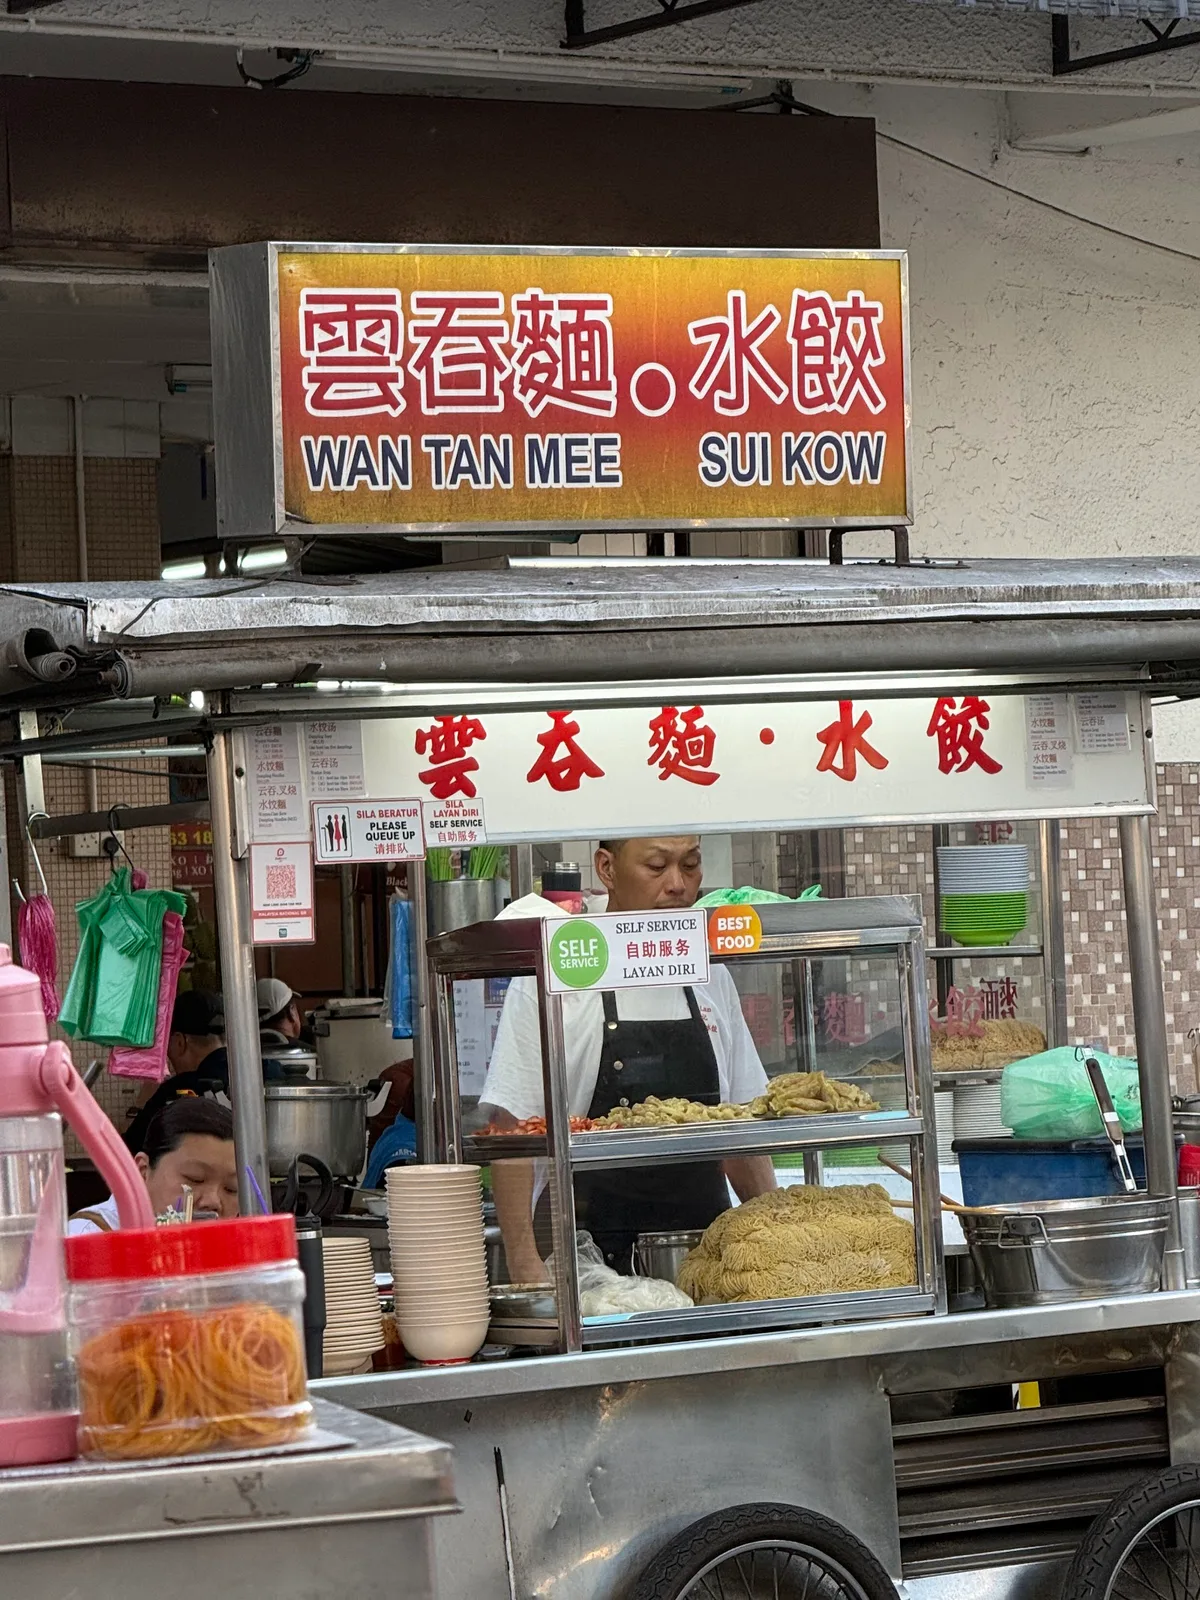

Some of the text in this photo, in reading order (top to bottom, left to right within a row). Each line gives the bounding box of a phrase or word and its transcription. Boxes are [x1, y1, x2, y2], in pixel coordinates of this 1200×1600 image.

[300, 288, 887, 417] 雲吞麵 水餃
[301, 430, 886, 490] WAN TAN MEE SUI KOW
[445, 800, 464, 809] SILA
[356, 808, 419, 819] SILA BERATUR
[433, 808, 479, 818] LAYAN DIRI
[370, 821, 408, 831] PLEASE
[430, 819, 483, 829] SELF SERVICE
[365, 831, 416, 842] QUEUE UP
[438, 831, 477, 843] 自助服务
[374, 842, 409, 855] 请排队
[616, 918, 697, 935] SELF SERVICE
[717, 916, 752, 931] BEST
[558, 938, 599, 958] SELF
[626, 938, 690, 960] 自助服务
[717, 935, 755, 950] FOOD
[560, 956, 599, 969] SERVICE
[623, 963, 696, 979] LAYAN DIRI
